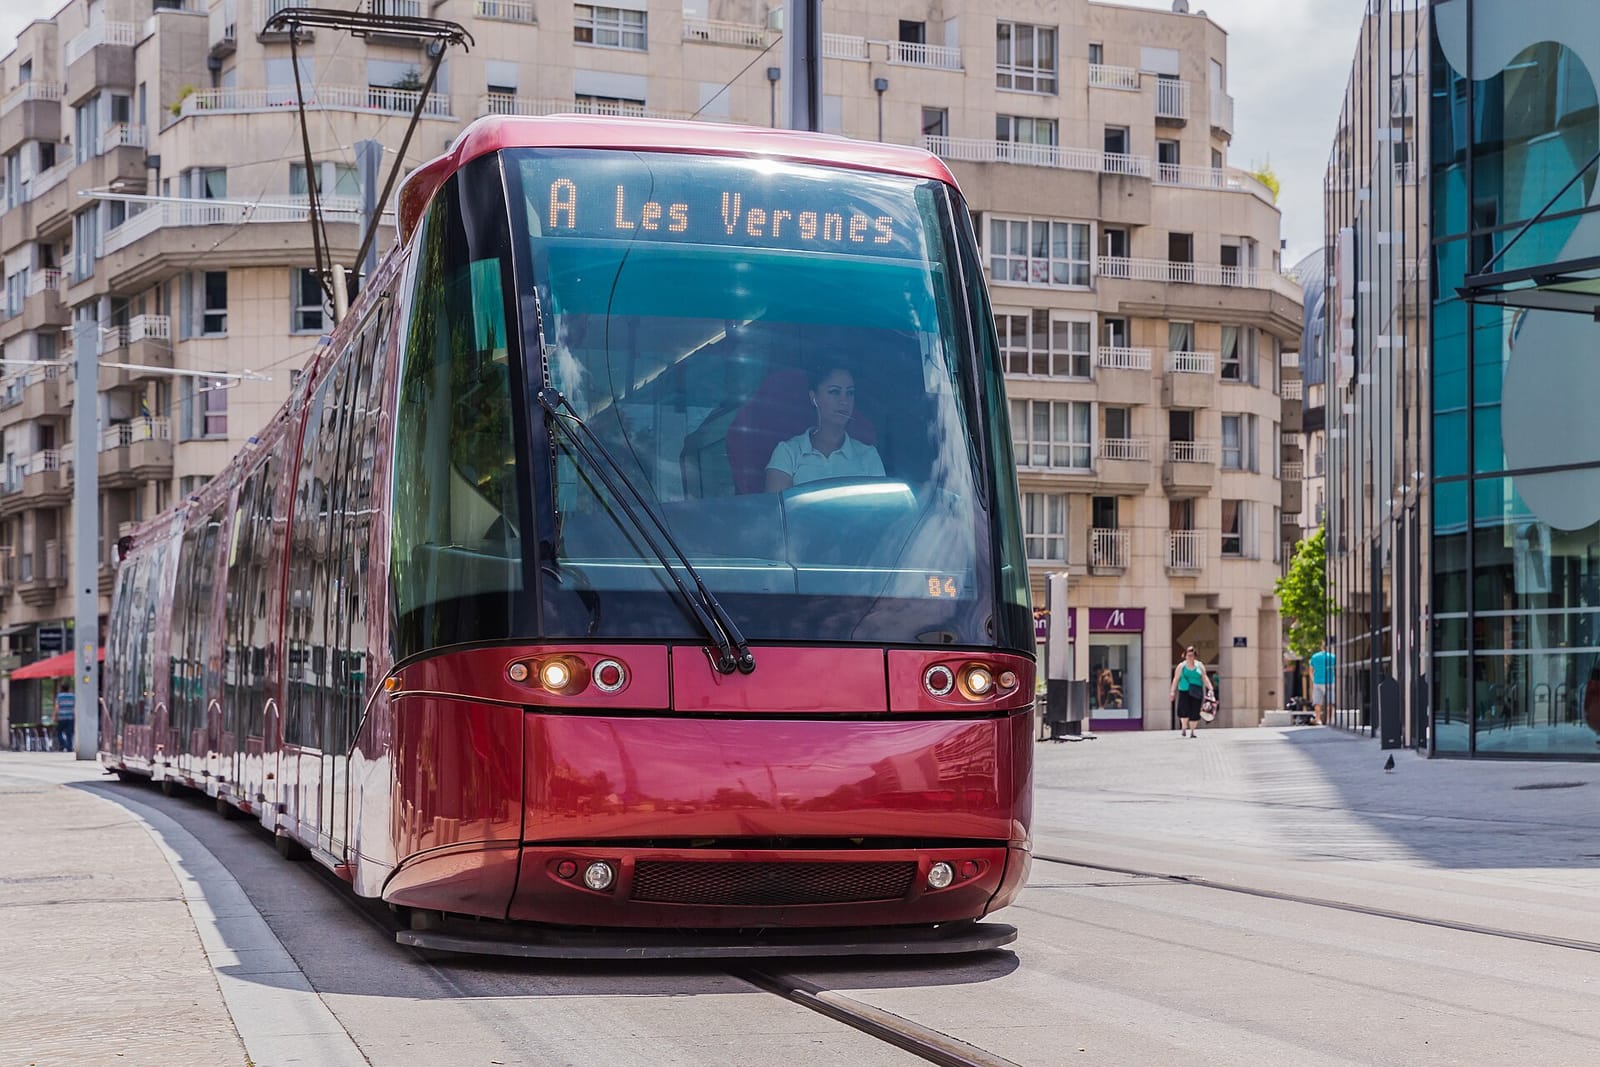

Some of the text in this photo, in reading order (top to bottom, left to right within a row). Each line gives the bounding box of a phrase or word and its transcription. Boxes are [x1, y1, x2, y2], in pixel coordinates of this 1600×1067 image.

[550, 178, 894, 244] A Les Vergnes
[1105, 609, 1125, 630] M
